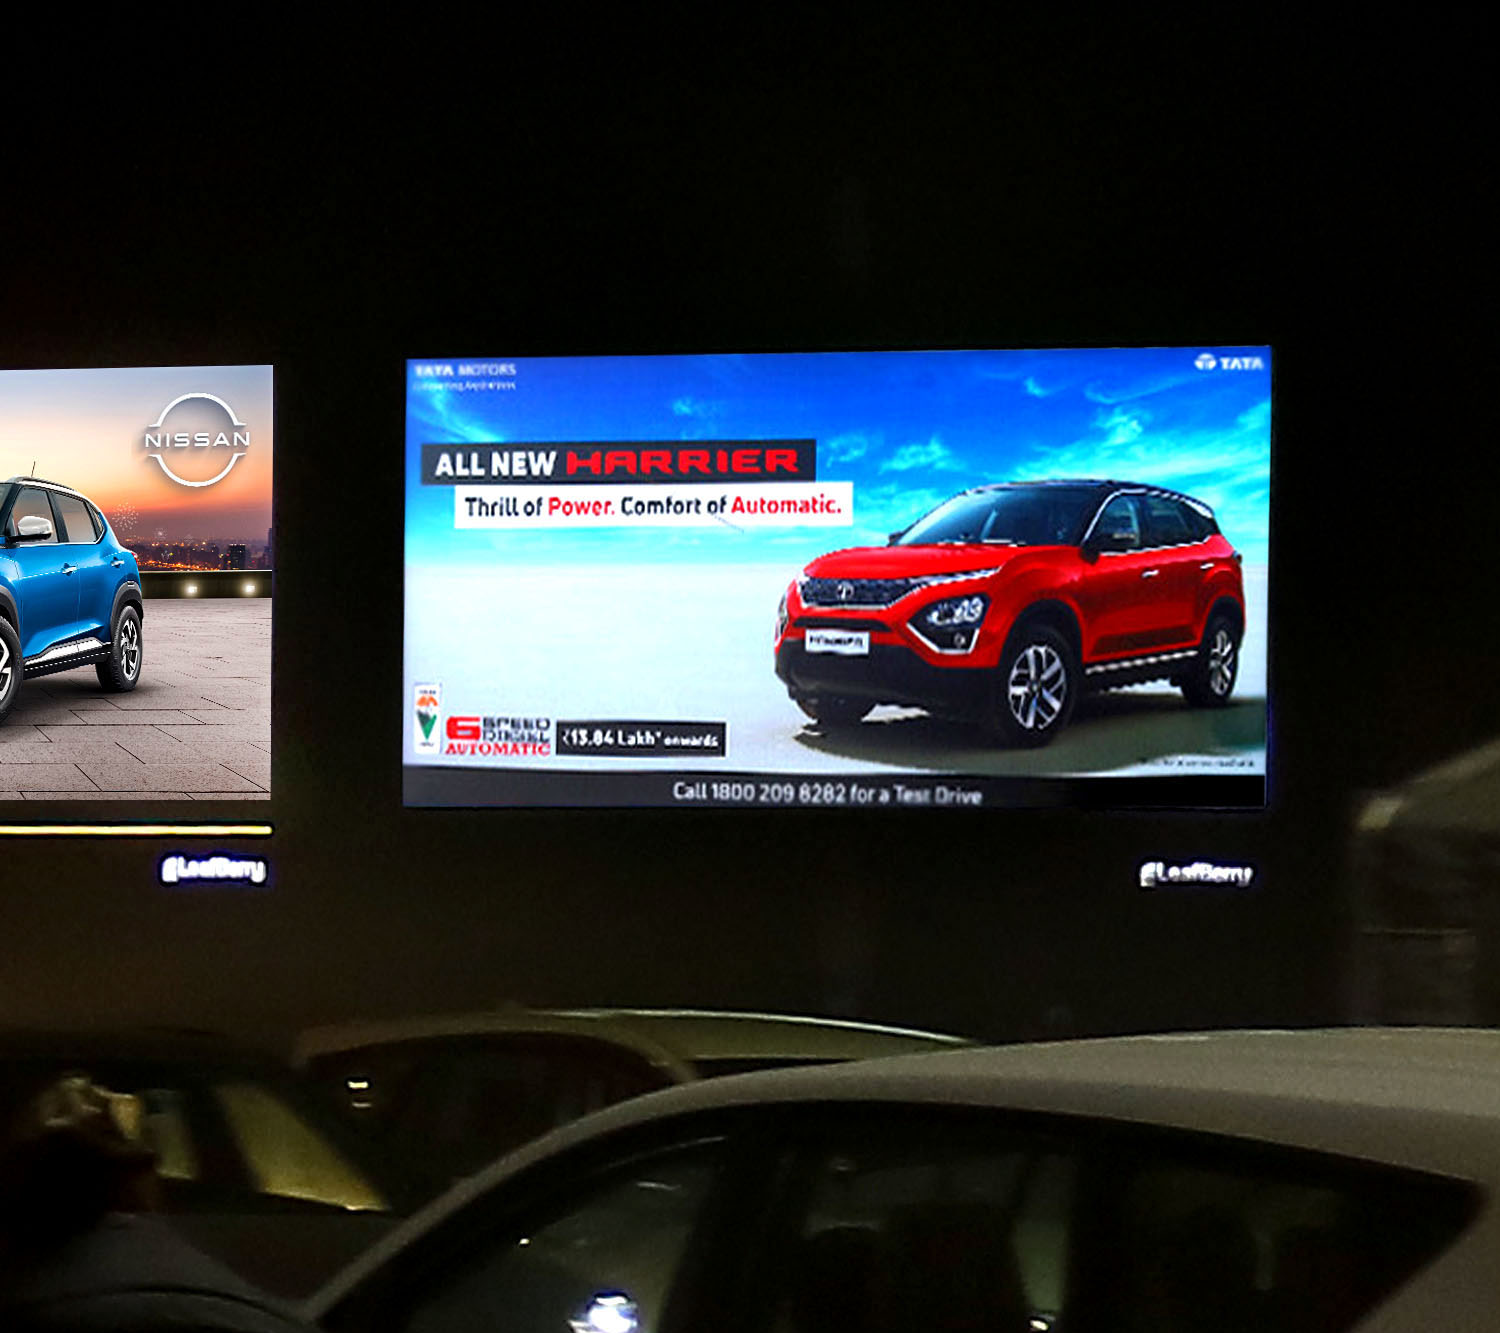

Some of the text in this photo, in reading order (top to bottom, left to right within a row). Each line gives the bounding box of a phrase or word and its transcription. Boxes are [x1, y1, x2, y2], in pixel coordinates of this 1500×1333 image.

[414, 363, 517, 377] TATA MOTORS
[1220, 357, 1264, 371] TATA
[145, 431, 250, 448] NISSAN
[435, 449, 799, 477] ALL NEW HARRIER
[465, 493, 842, 517] Thrill of Power. Comfort of Automatic.
[446, 716, 481, 741] 6
[445, 742, 551, 756] AUTOMATIC
[672, 781, 984, 806] Call 1800 209 8282 for a Test Drive
